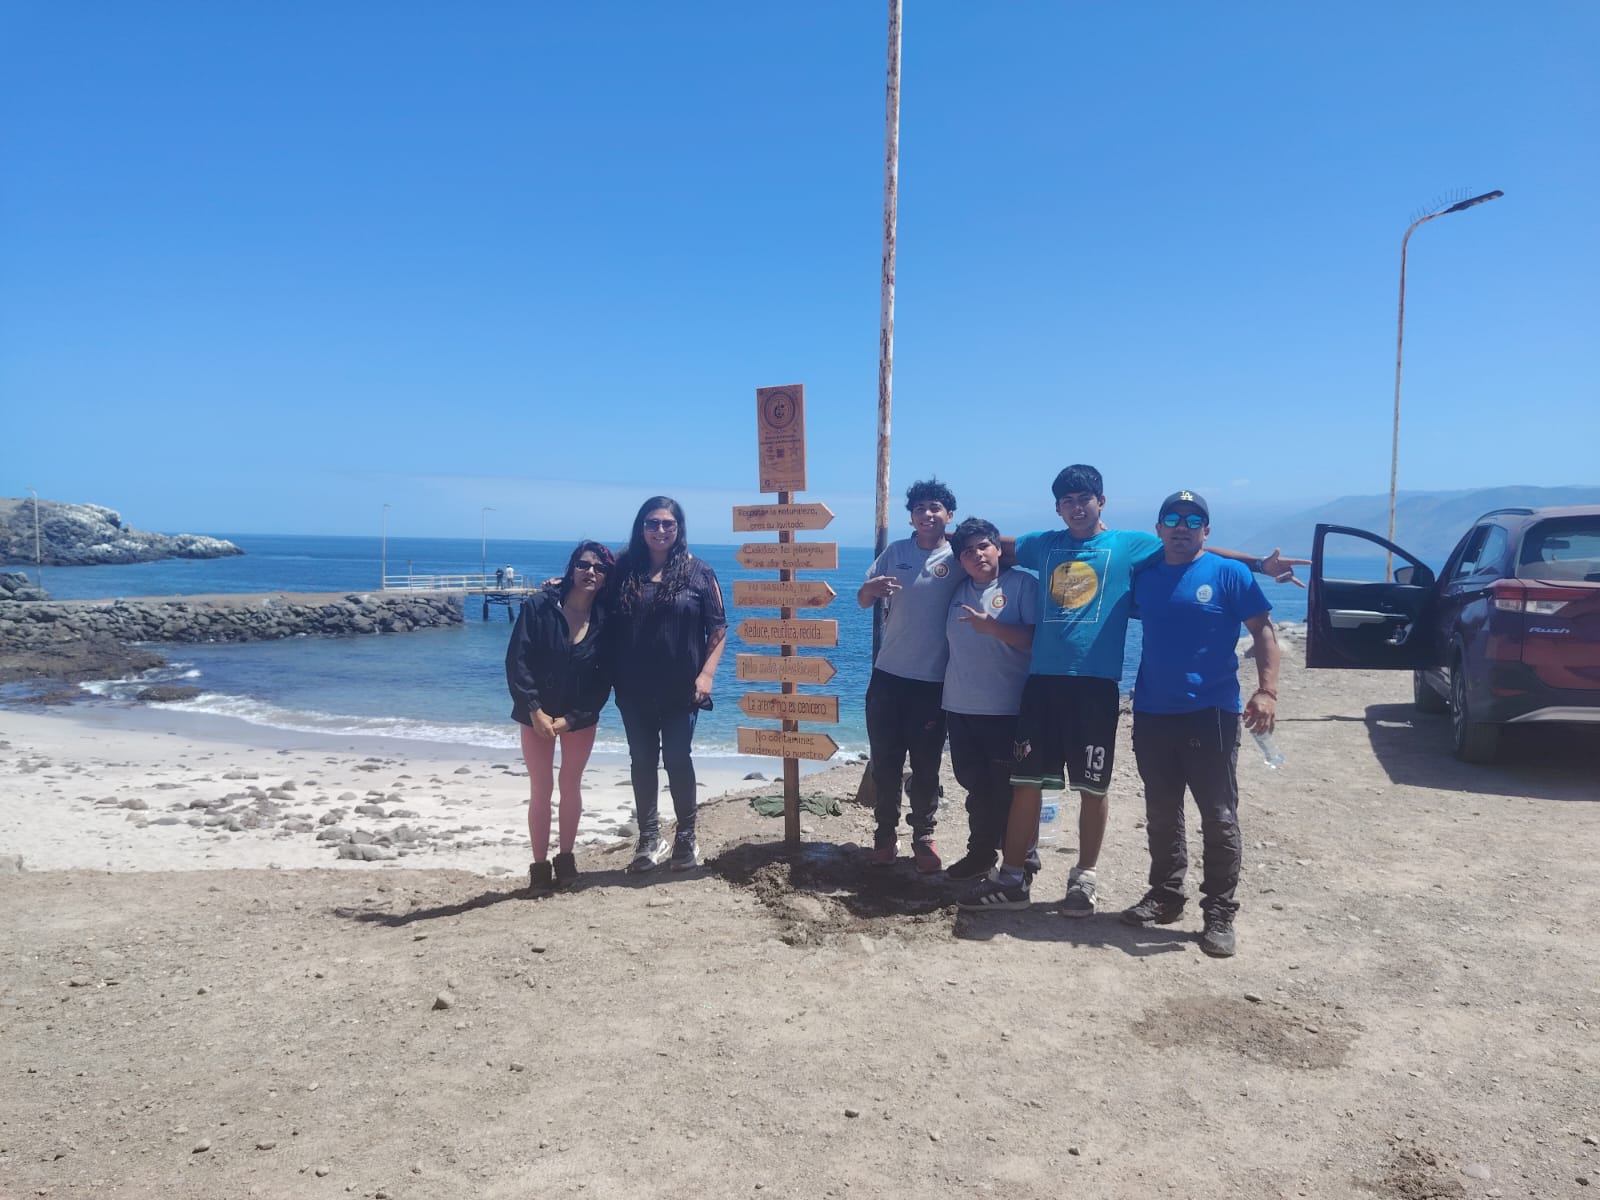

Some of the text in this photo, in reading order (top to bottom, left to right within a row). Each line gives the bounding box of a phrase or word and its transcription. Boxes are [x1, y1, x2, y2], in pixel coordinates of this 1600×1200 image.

[1180, 490, 1193, 501] LA
[744, 622, 770, 640] Reduce,
[1528, 626, 1571, 634] Rush
[747, 696, 756, 711] La
[776, 701, 786, 713] no
[788, 701, 796, 713] es
[755, 730, 767, 744] No
[782, 745, 791, 758] lo
[1085, 744, 1106, 770] 13
